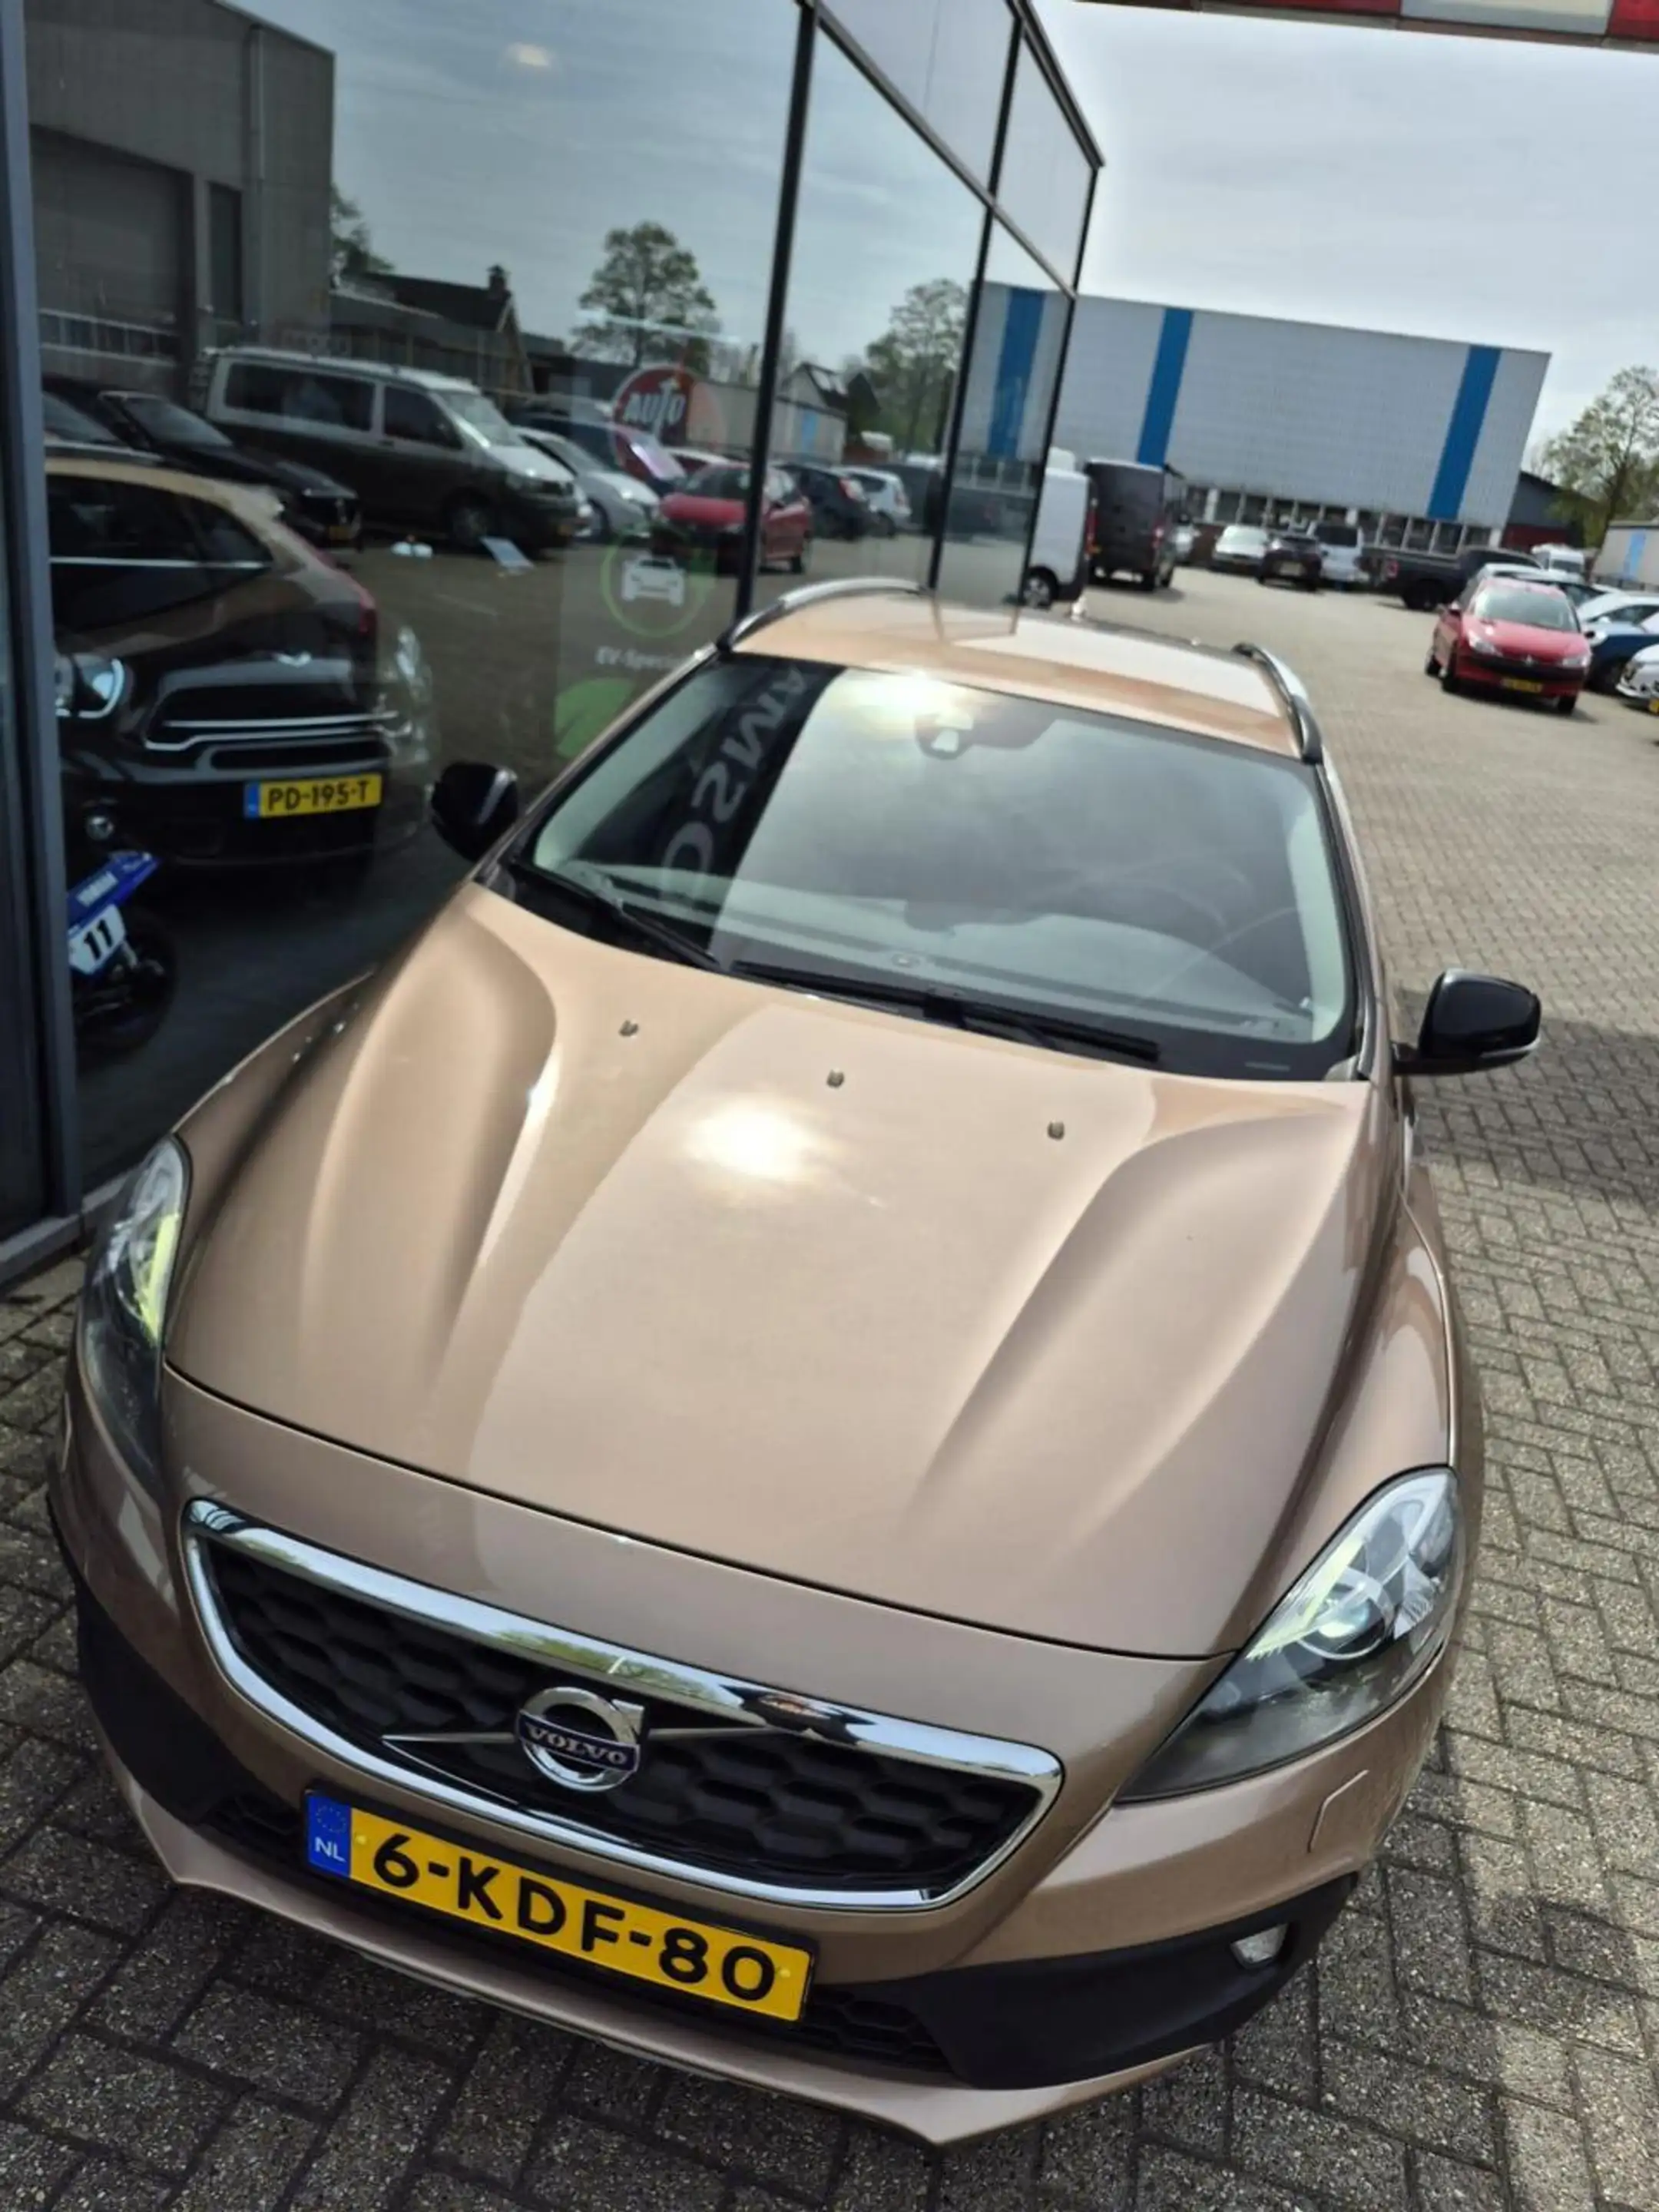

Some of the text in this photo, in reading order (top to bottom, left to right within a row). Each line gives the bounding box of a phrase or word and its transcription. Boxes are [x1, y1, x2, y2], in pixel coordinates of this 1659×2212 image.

[268, 780, 369, 813] PD-195-T
[84, 919, 113, 960] 11
[525, 1722, 628, 1764] VOLVO
[314, 1832, 775, 2002] NL 6-KDF-80
